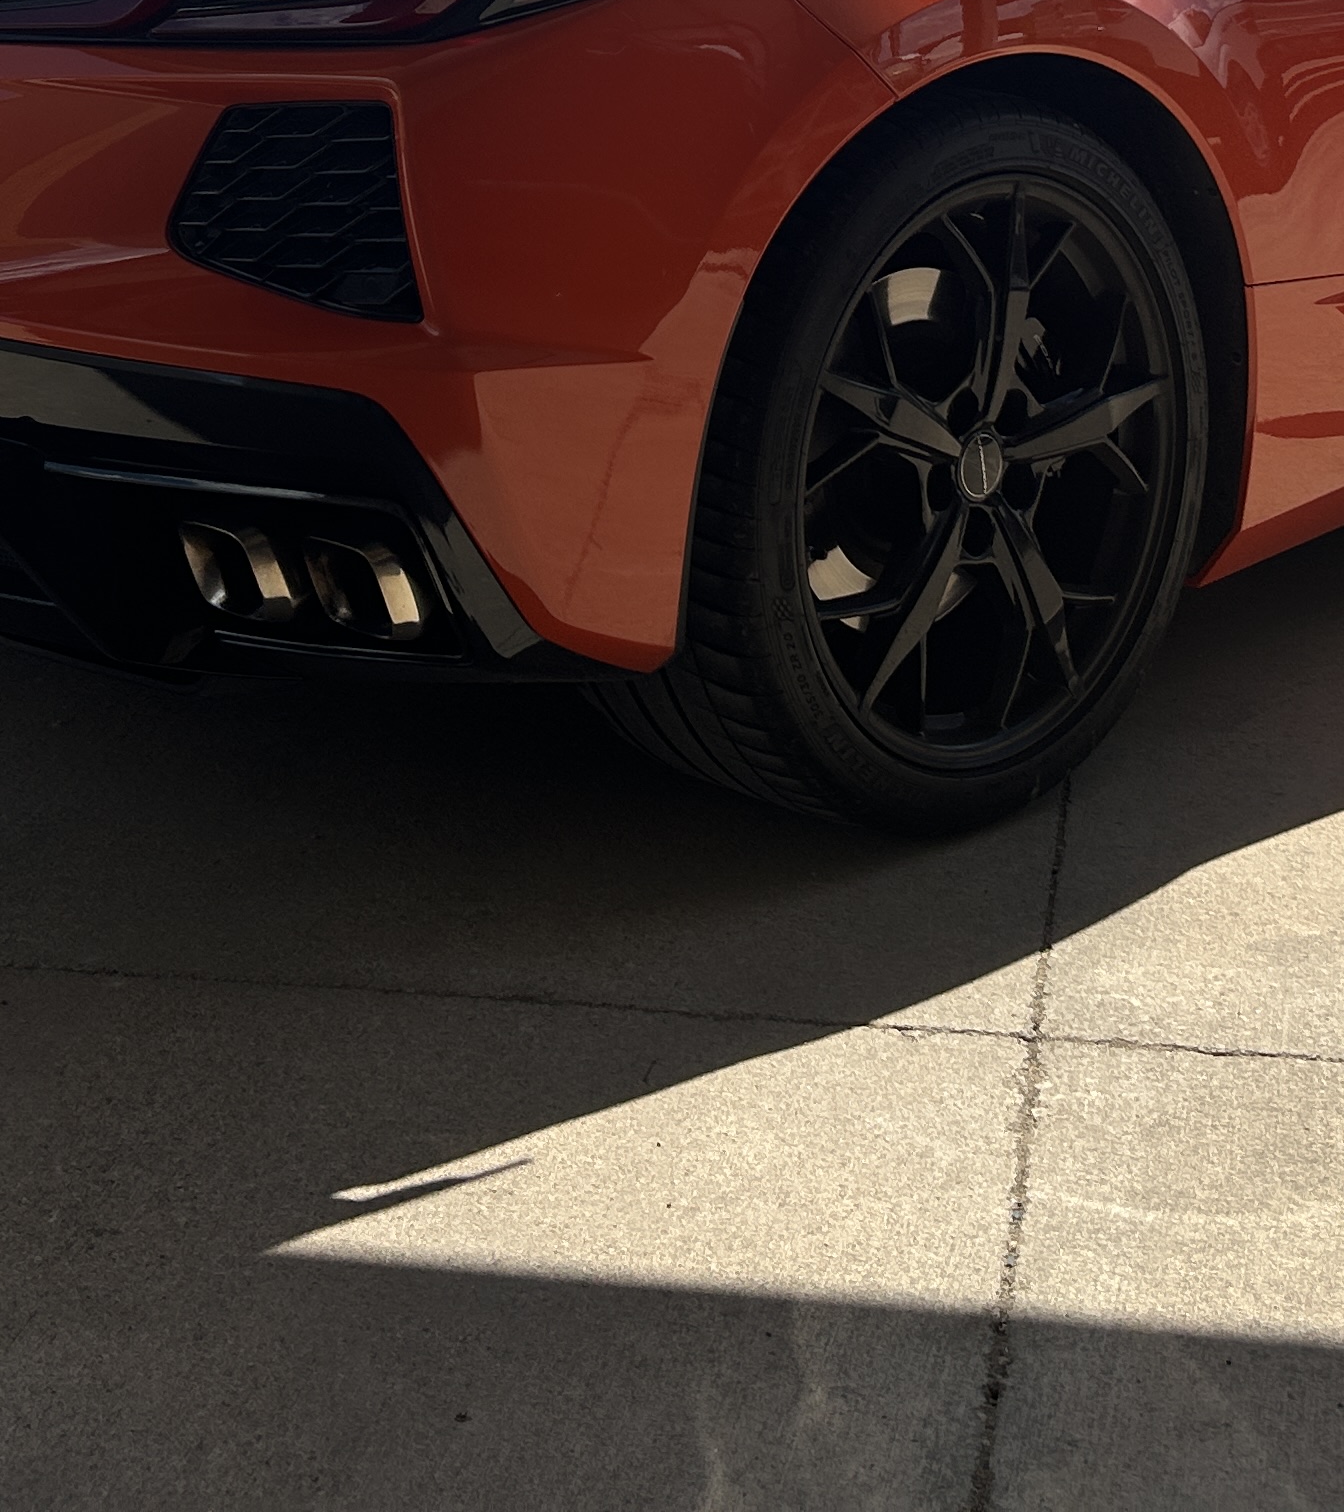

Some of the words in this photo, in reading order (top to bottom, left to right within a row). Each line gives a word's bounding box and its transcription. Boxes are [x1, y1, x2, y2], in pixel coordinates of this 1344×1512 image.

[1068, 144, 1159, 236] MICHELIN
[1163, 248, 1182, 287] PILOT
[1177, 292, 1194, 337] SPORT
[782, 632, 797, 650] 20
[789, 652, 803, 672] ZR
[796, 673, 824, 719] 305/30
